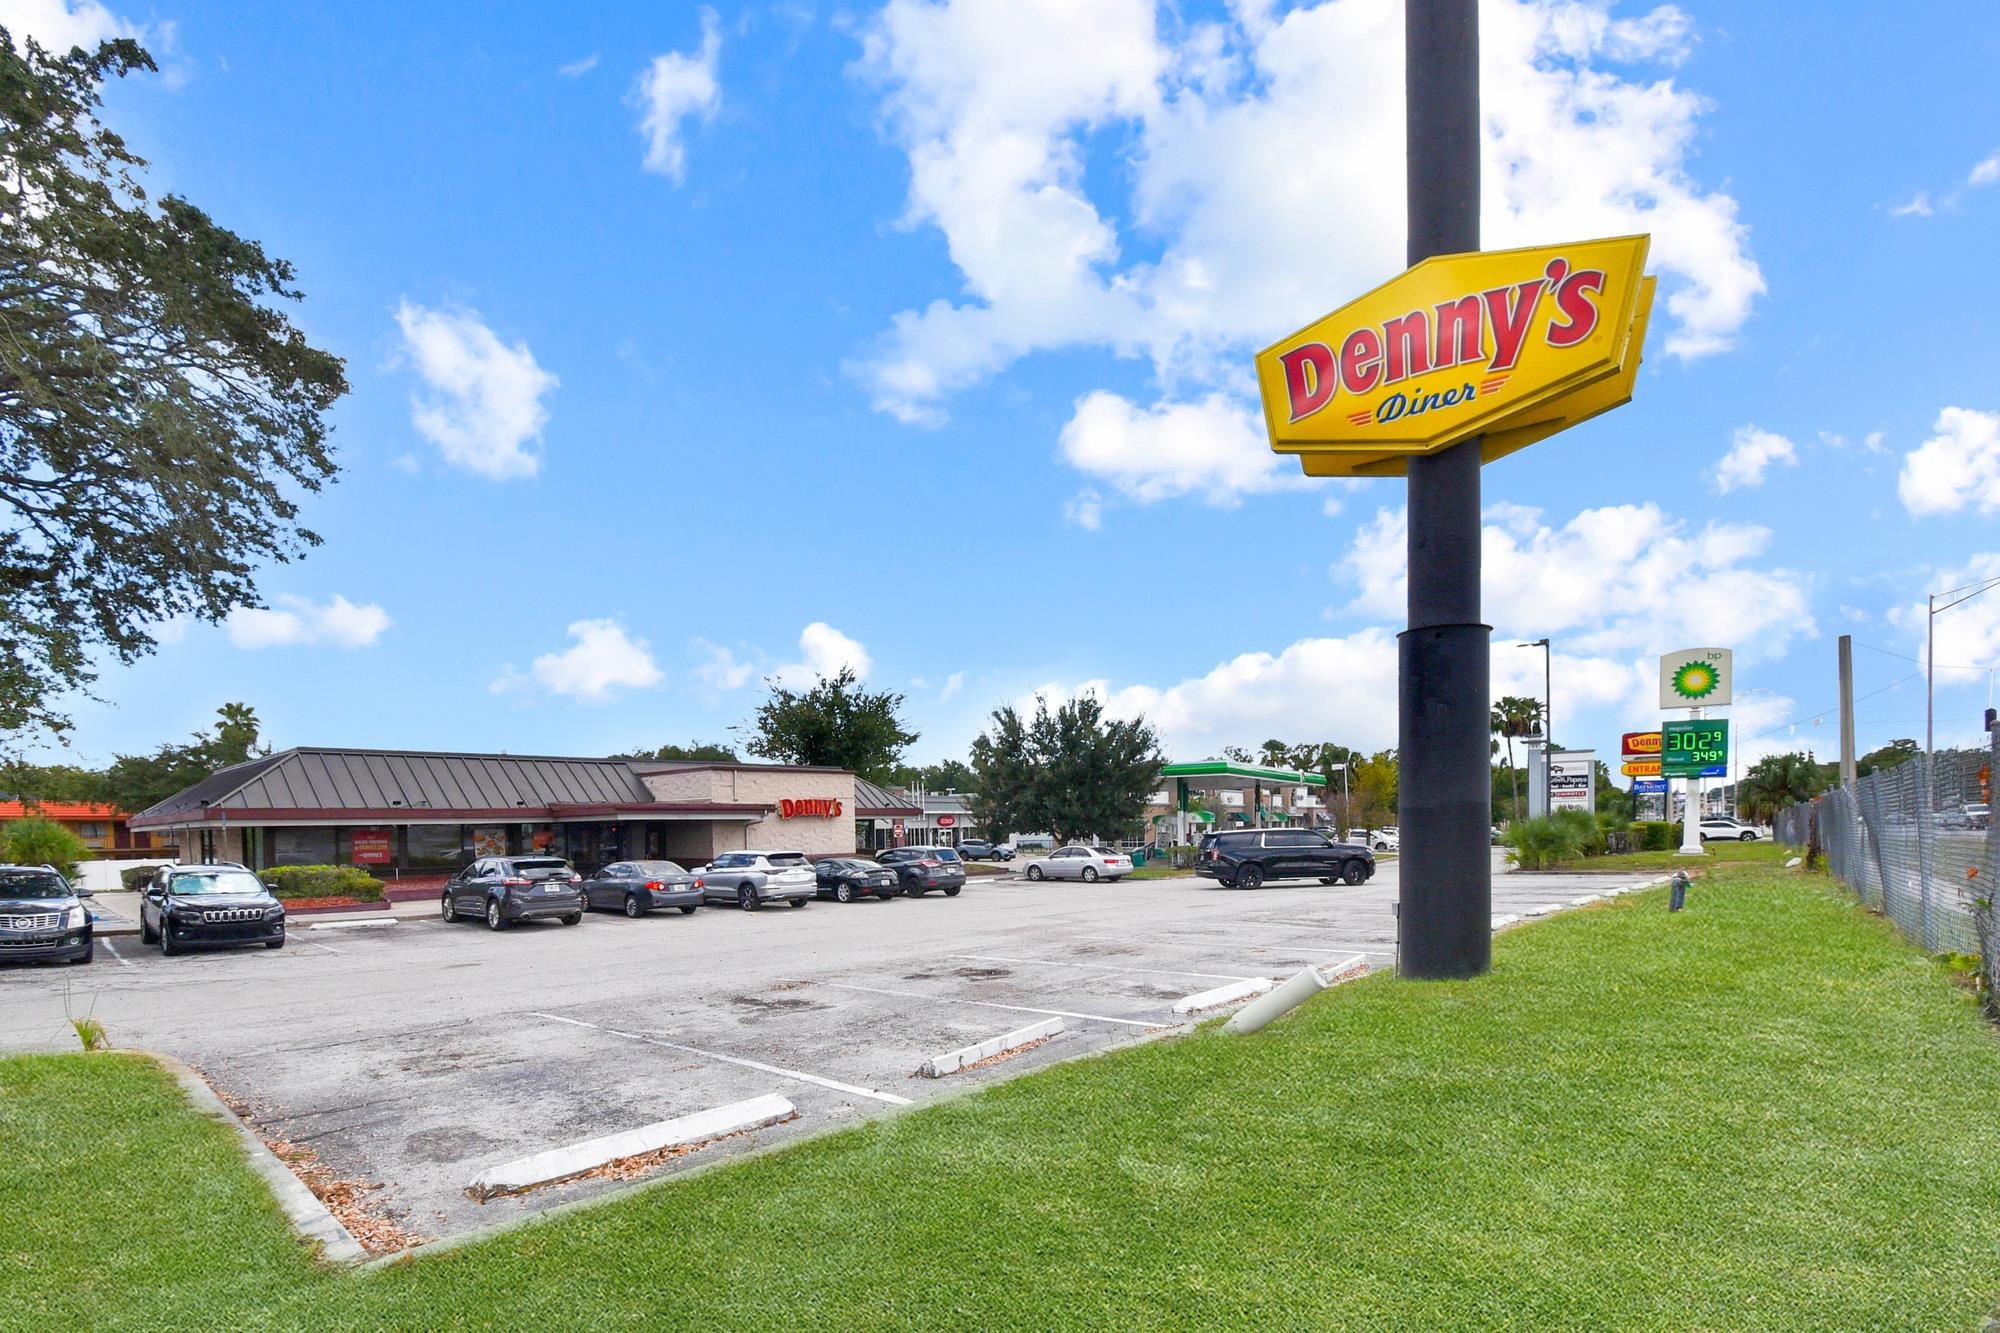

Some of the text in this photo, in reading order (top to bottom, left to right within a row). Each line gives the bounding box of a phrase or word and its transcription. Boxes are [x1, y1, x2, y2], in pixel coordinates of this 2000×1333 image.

[1279, 256, 1606, 424] Denny's
[1376, 381, 1477, 424] Diner
[1707, 651, 1722, 661] bp
[1632, 738, 1661, 747] Denn
[779, 798, 843, 821] Denny's
